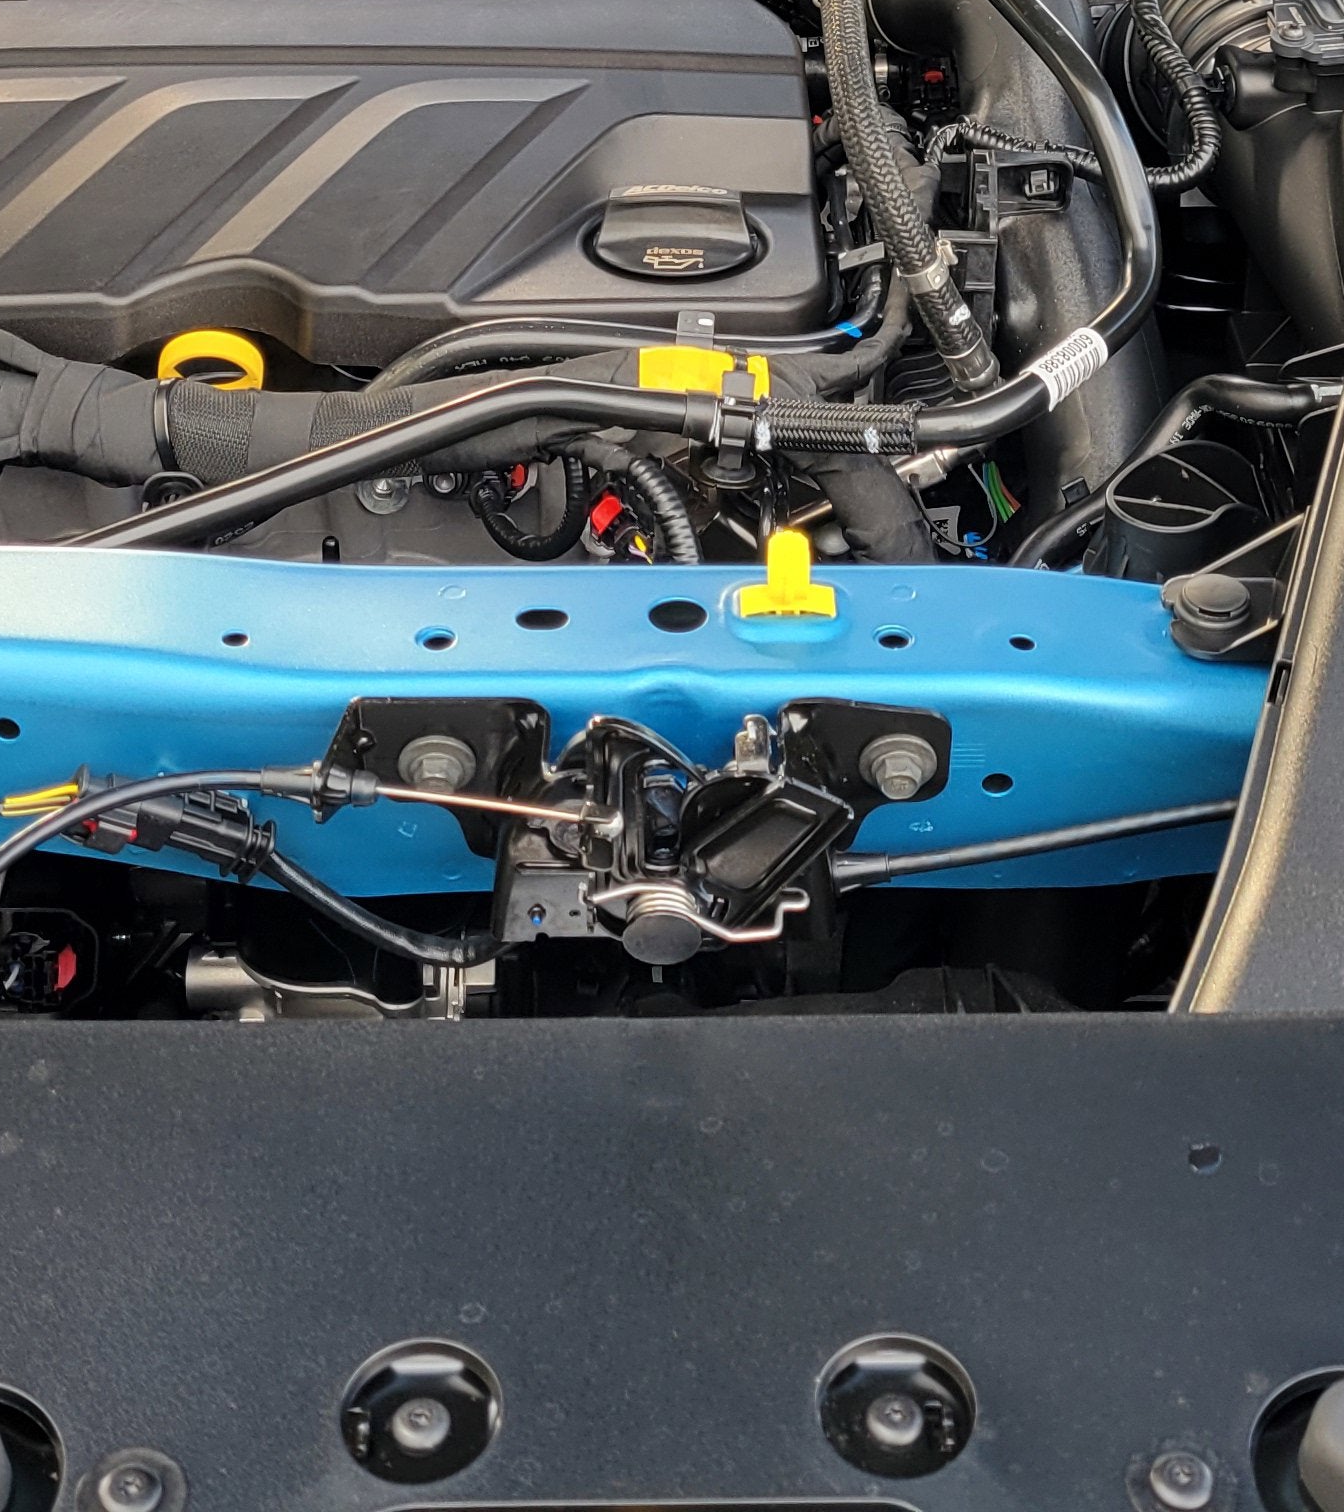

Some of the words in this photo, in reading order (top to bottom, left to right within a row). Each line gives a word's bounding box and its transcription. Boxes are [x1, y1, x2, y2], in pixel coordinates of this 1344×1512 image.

[622, 184, 728, 196] ACDelco
[646, 247, 704, 255] dexos
[1039, 334, 1093, 374] 60008388
